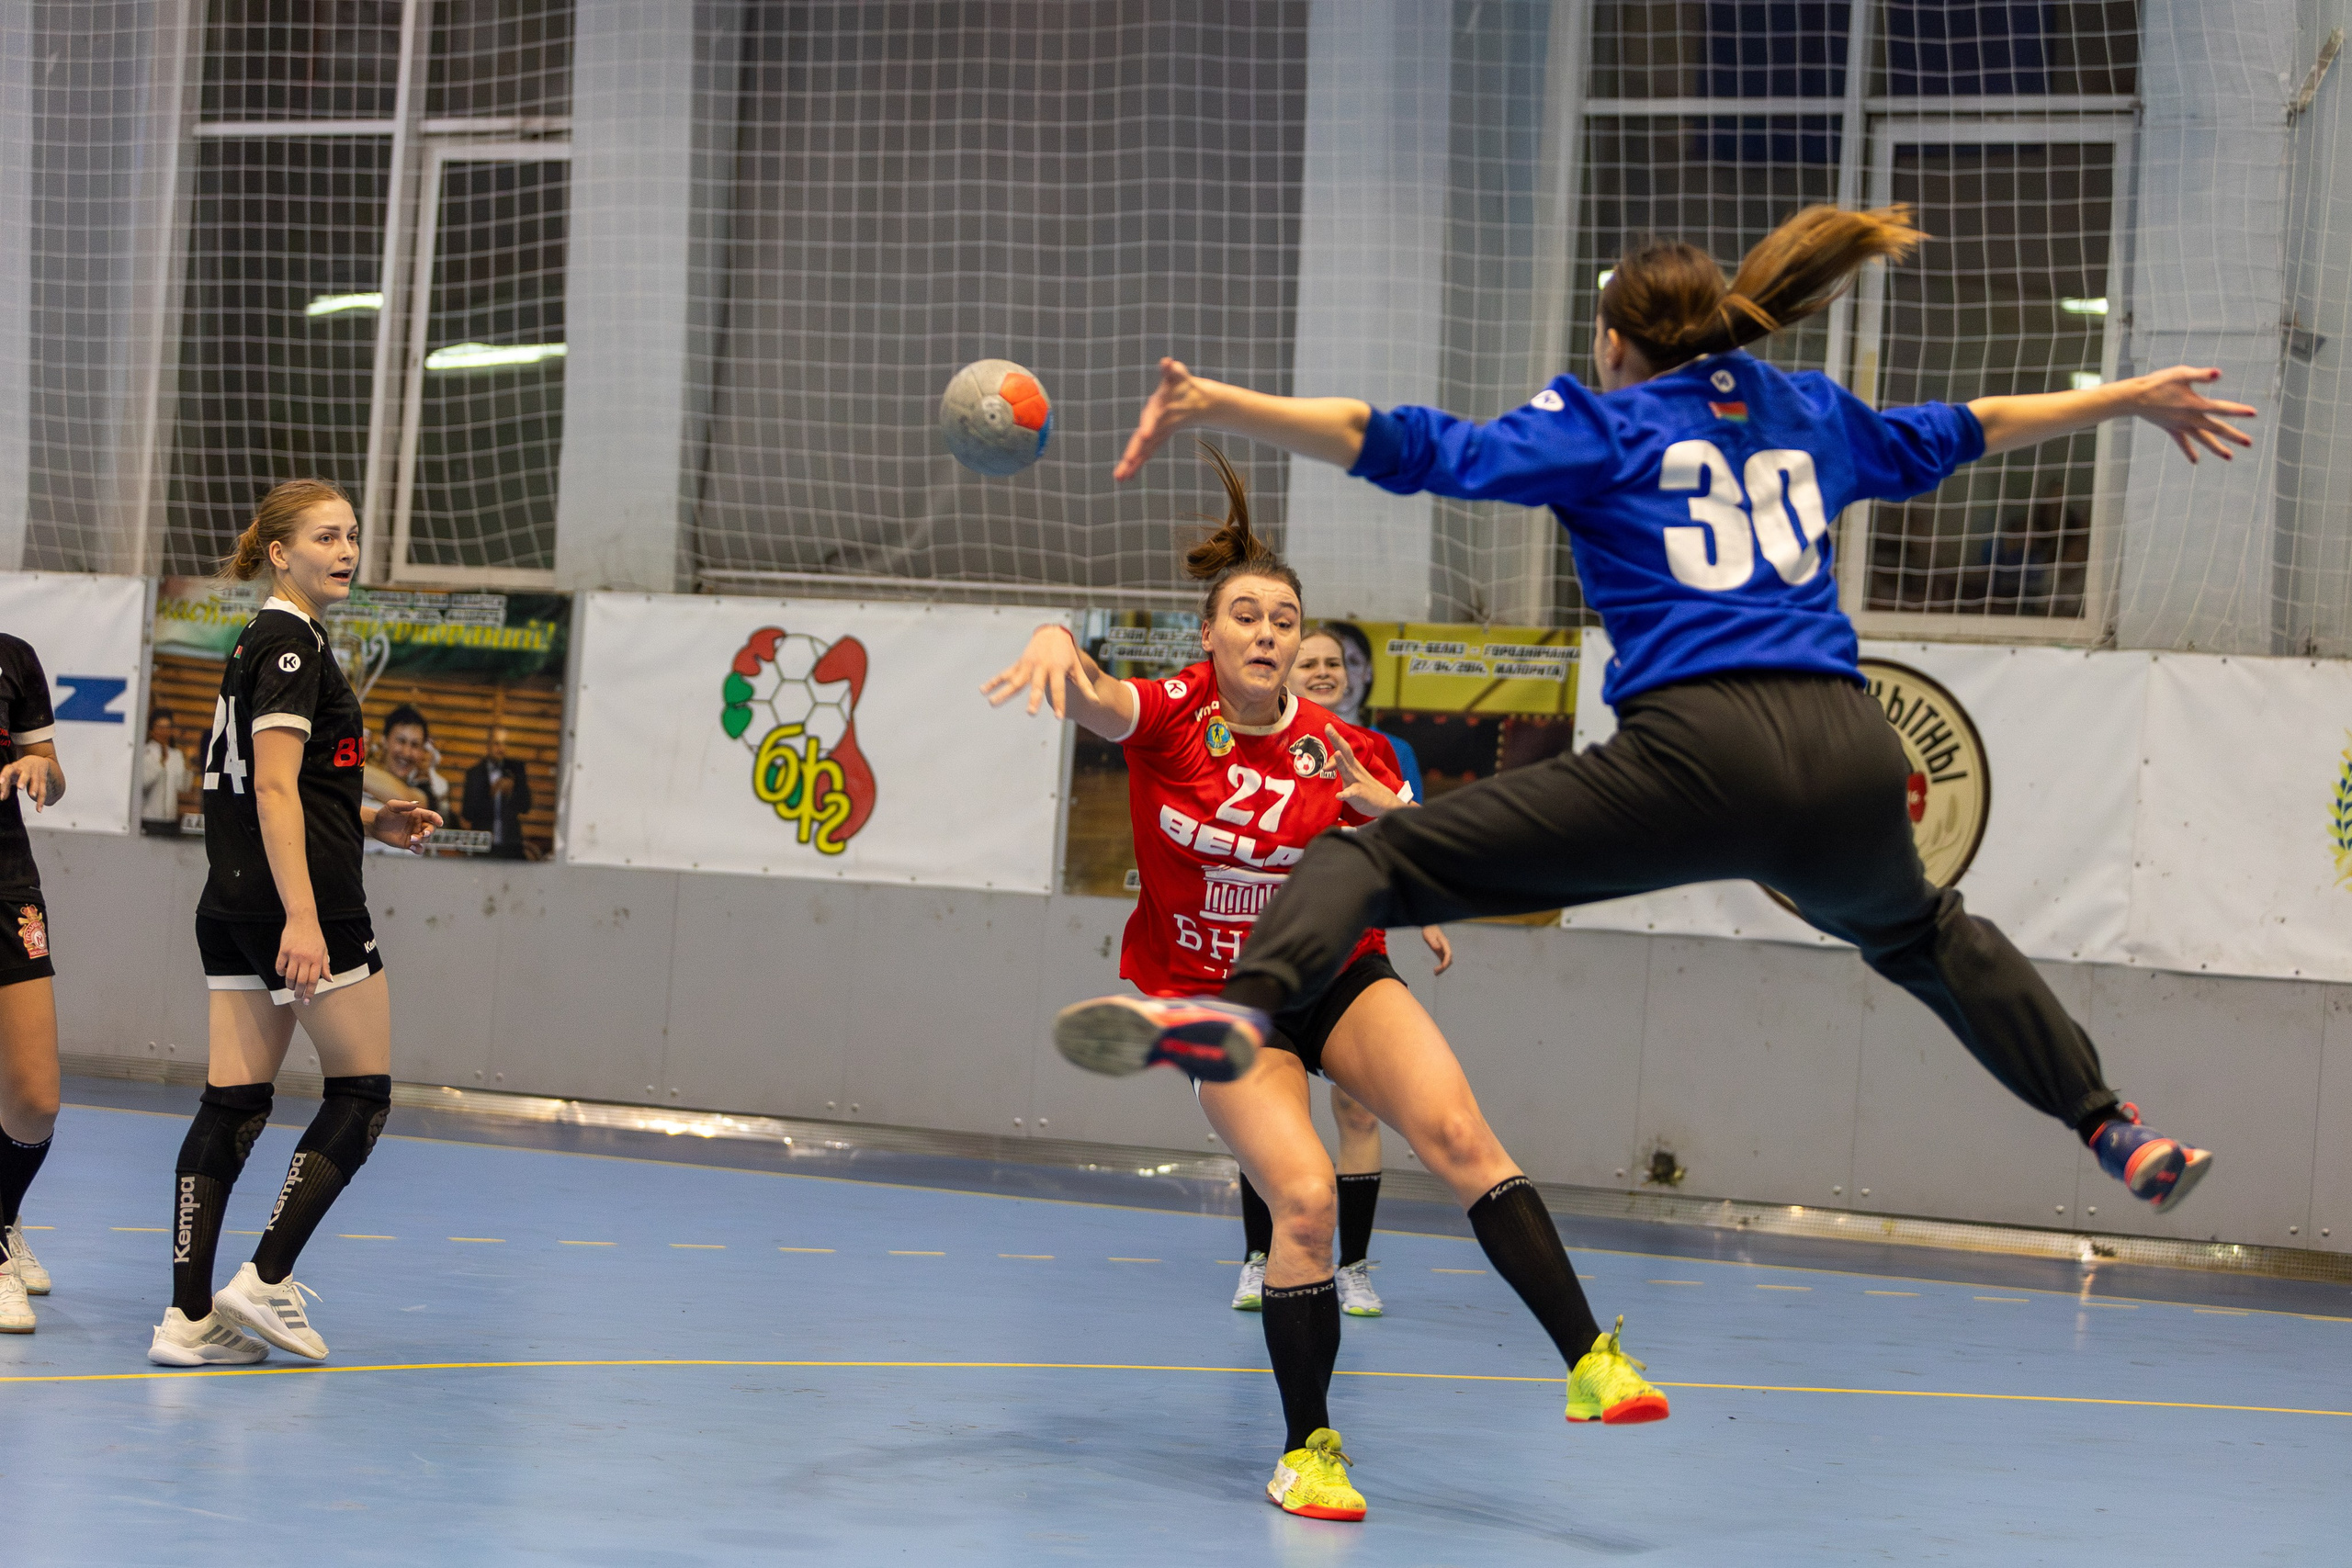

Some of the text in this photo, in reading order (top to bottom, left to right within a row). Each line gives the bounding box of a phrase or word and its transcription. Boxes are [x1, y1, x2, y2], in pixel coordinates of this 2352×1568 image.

[1659, 439, 1827, 592] 30
[203, 694, 247, 795] 24
[1216, 763, 1295, 834] 27
[1173, 913, 1245, 964] БН
[174, 1176, 201, 1264] Kempa
[266, 1152, 308, 1232] Kempa
